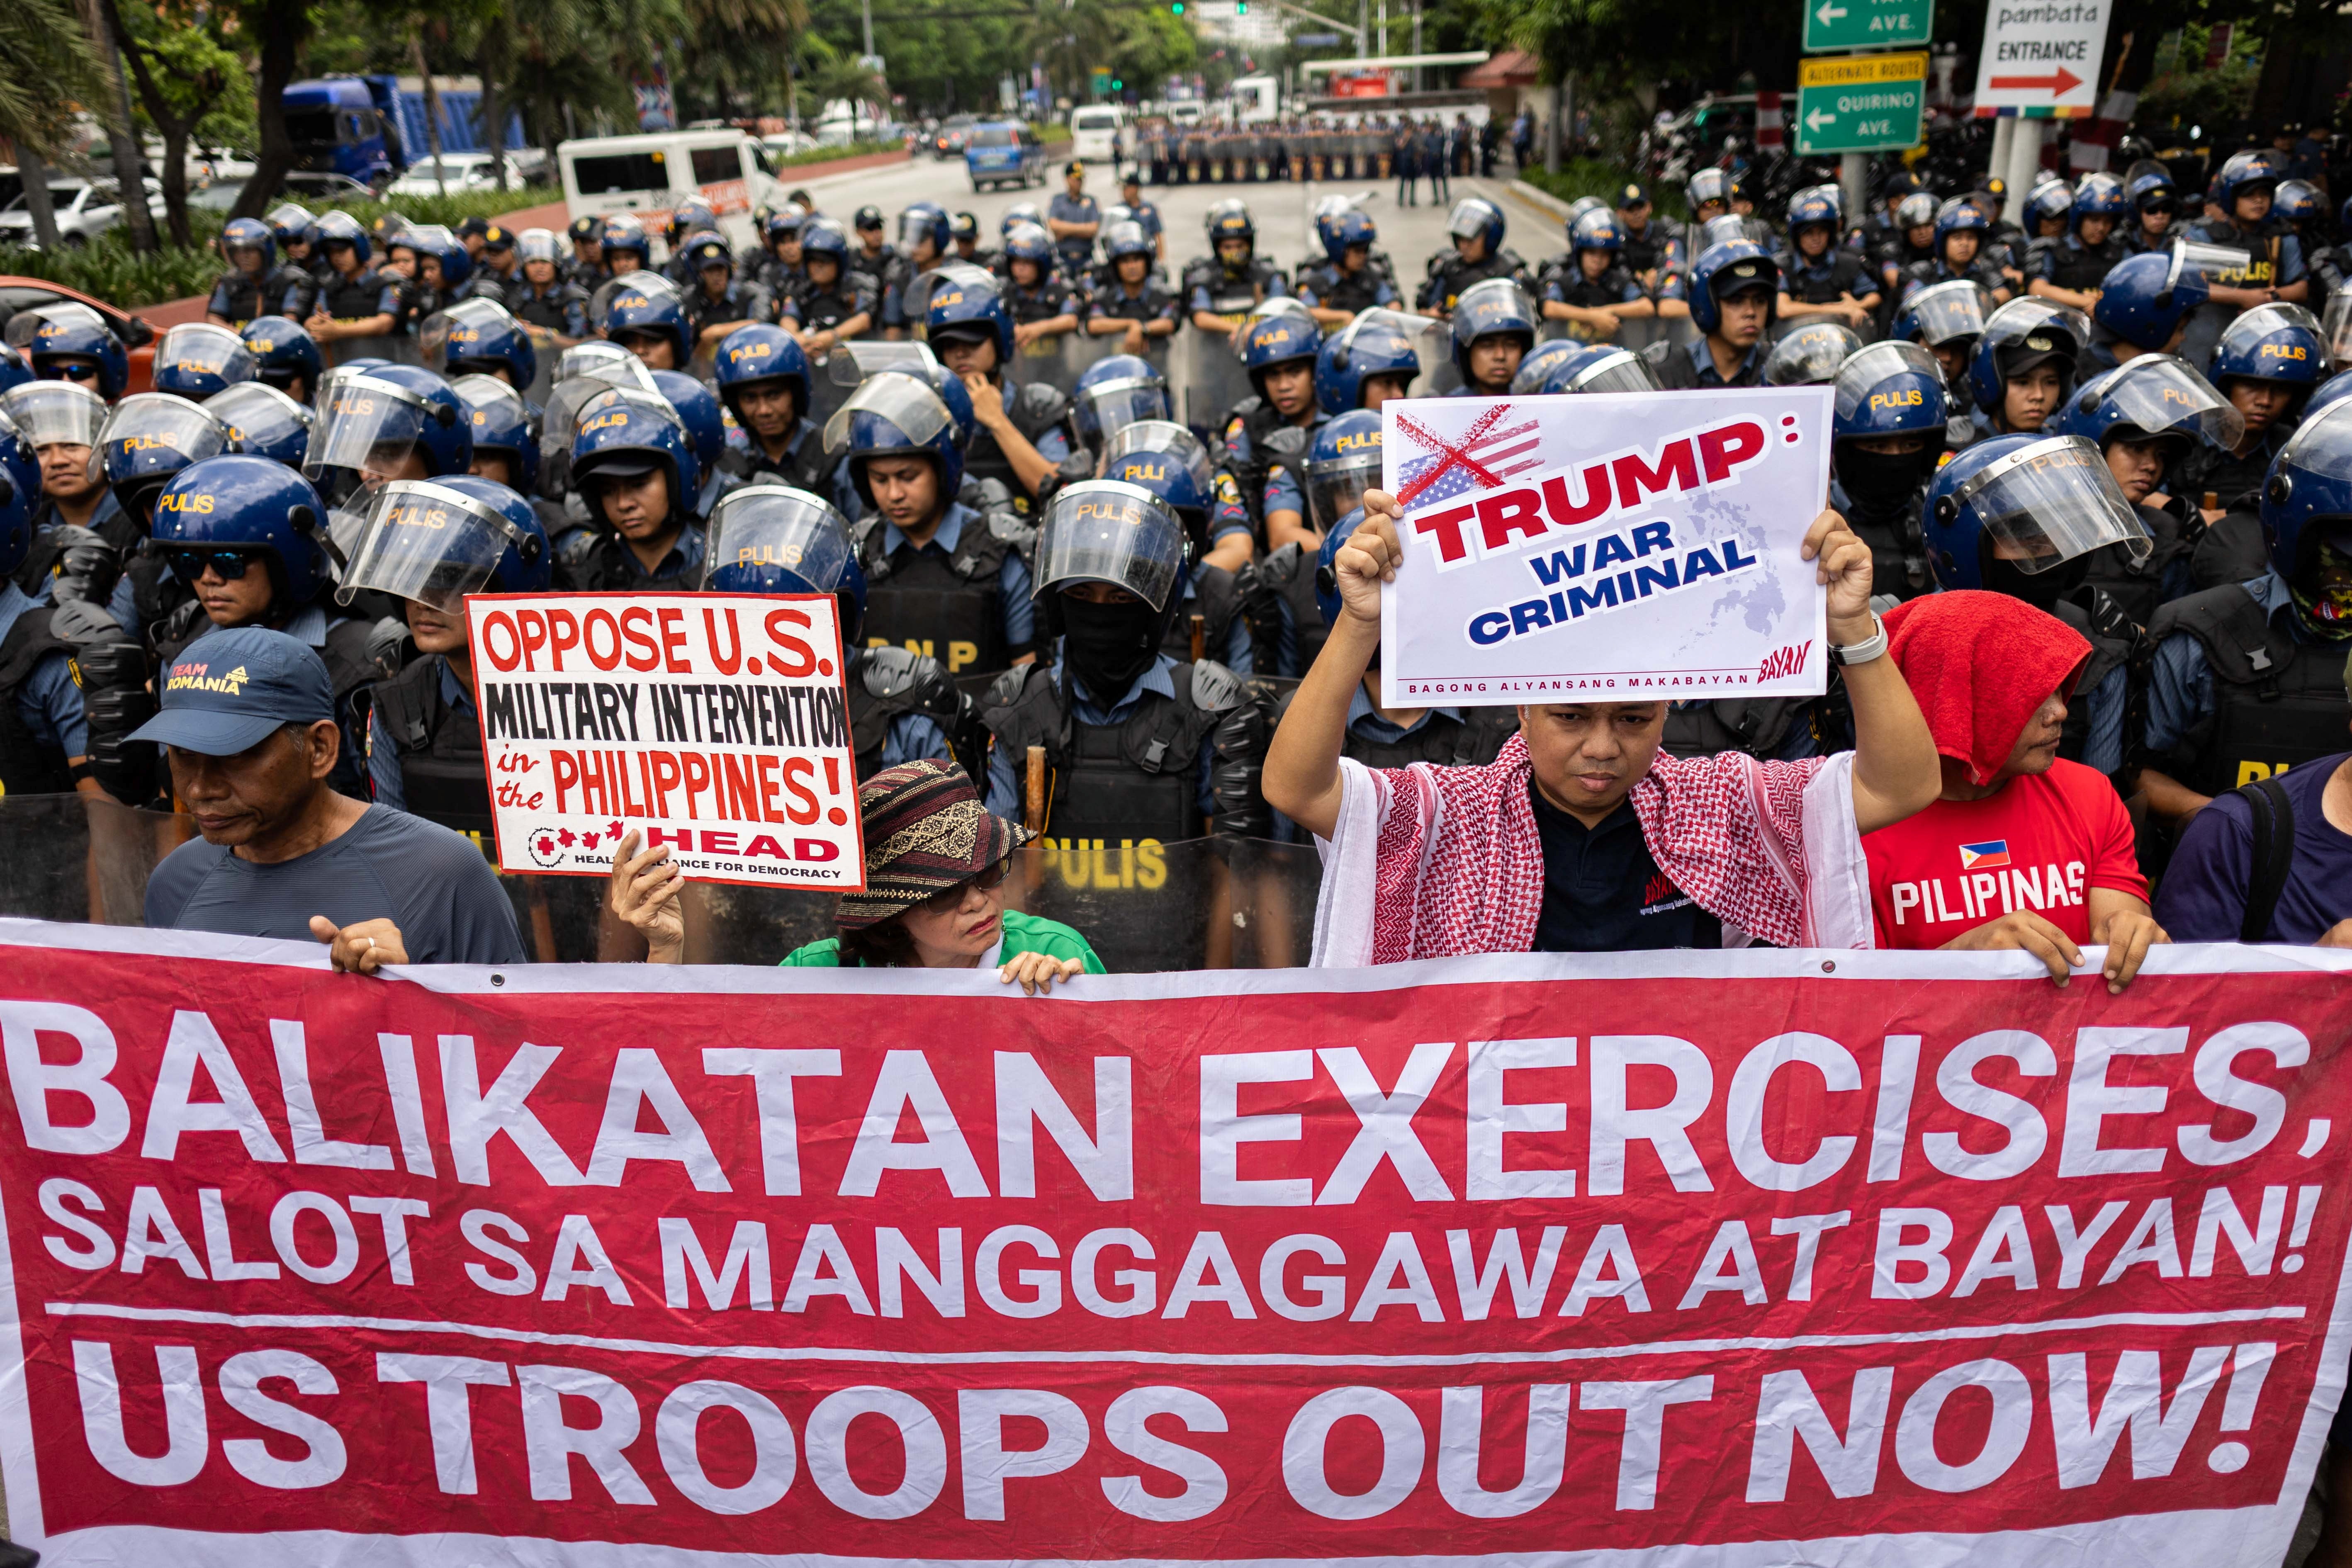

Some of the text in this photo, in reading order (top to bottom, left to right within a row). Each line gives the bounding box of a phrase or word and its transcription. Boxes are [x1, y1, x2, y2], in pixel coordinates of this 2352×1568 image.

[1869, 13, 1915, 32] AVE.
[1997, 3, 2098, 32] pambata
[1998, 41, 2087, 61] ENTRANCE
[1809, 60, 1920, 82] ALTERNATE ROUTE
[1837, 92, 1915, 113] QUIRINO
[1856, 119, 1896, 136] AVE.
[731, 344, 771, 363] PULIS
[2262, 344, 2306, 361] PULIS
[1870, 390, 1923, 411] PULIS
[581, 413, 628, 436] PULIS
[124, 433, 178, 454] PULIS
[159, 494, 214, 514] PULIS
[1077, 504, 1141, 525] PULIS
[386, 507, 447, 530] PULIS
[739, 544, 802, 569] PULIS
[1530, 521, 1674, 587] WAR
[1468, 539, 1756, 645] CRIMINAL
[483, 606, 833, 677] OPPOSE U.S.
[868, 637, 978, 673] NP
[1757, 639, 1813, 685] BAYAN
[172, 664, 208, 677] TEAM
[225, 673, 250, 684] PEAK
[167, 676, 240, 695] ROMANIA
[1409, 674, 1749, 693] BAGONG ALYANSANG MAKABAYAN
[485, 683, 852, 747] MILITARY INTERVENTION
[496, 743, 540, 773] in
[496, 780, 543, 810] the
[550, 750, 848, 826] PHILIPPINES!
[647, 827, 839, 863] HEAD
[575, 855, 616, 864] HEAL
[715, 863, 744, 872] FOR
[748, 865, 841, 879] DEMOCRACY
[1892, 861, 2085, 925] PILIPINAS
[0, 999, 2331, 1206] BALIKATAN EXERCISES,
[38, 1177, 2323, 1322] SALOT SA MANGGAGAWA AT BAYAN!
[73, 1340, 2277, 1522] US TROOPS OUT NOW!
